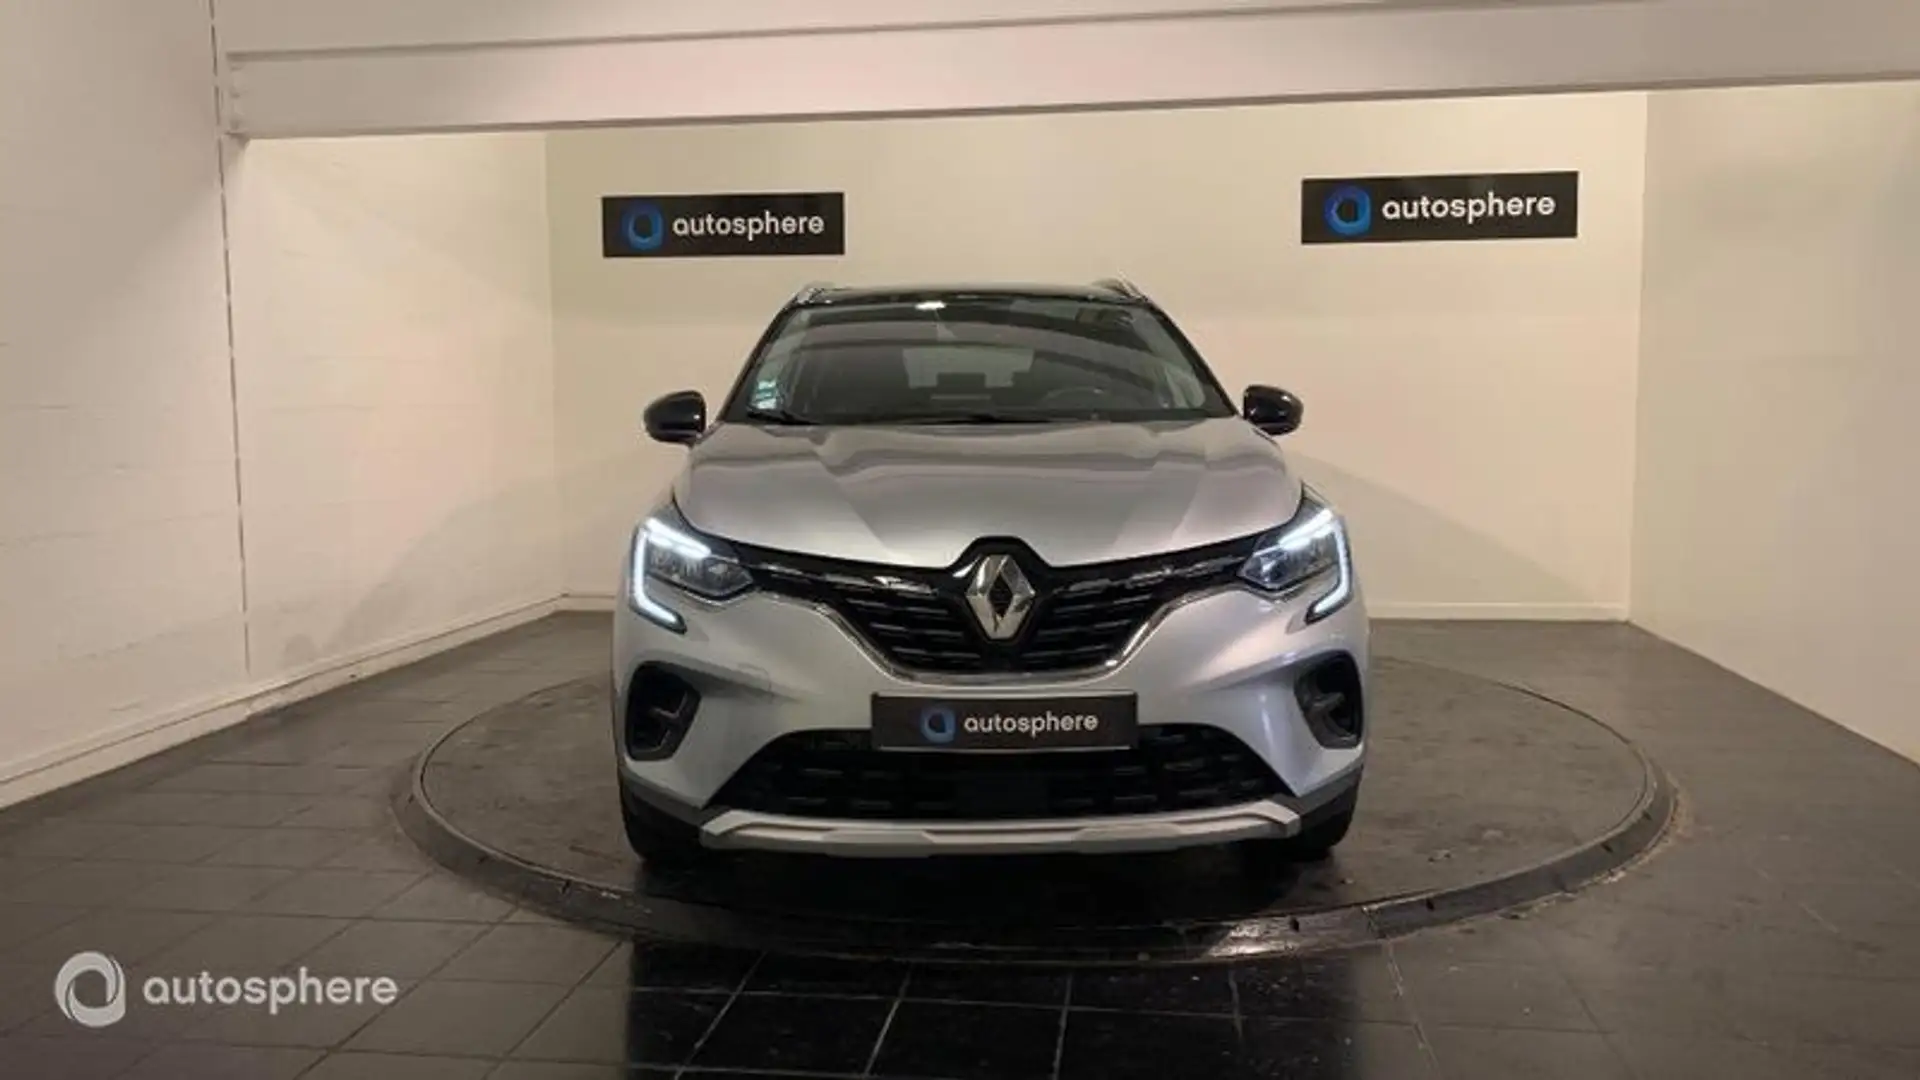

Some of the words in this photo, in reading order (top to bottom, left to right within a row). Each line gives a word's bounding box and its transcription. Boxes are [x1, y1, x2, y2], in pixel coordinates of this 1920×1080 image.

[1382, 190, 1556, 224] autosphere
[672, 210, 825, 241] autosphere
[963, 710, 1099, 738] autosphere
